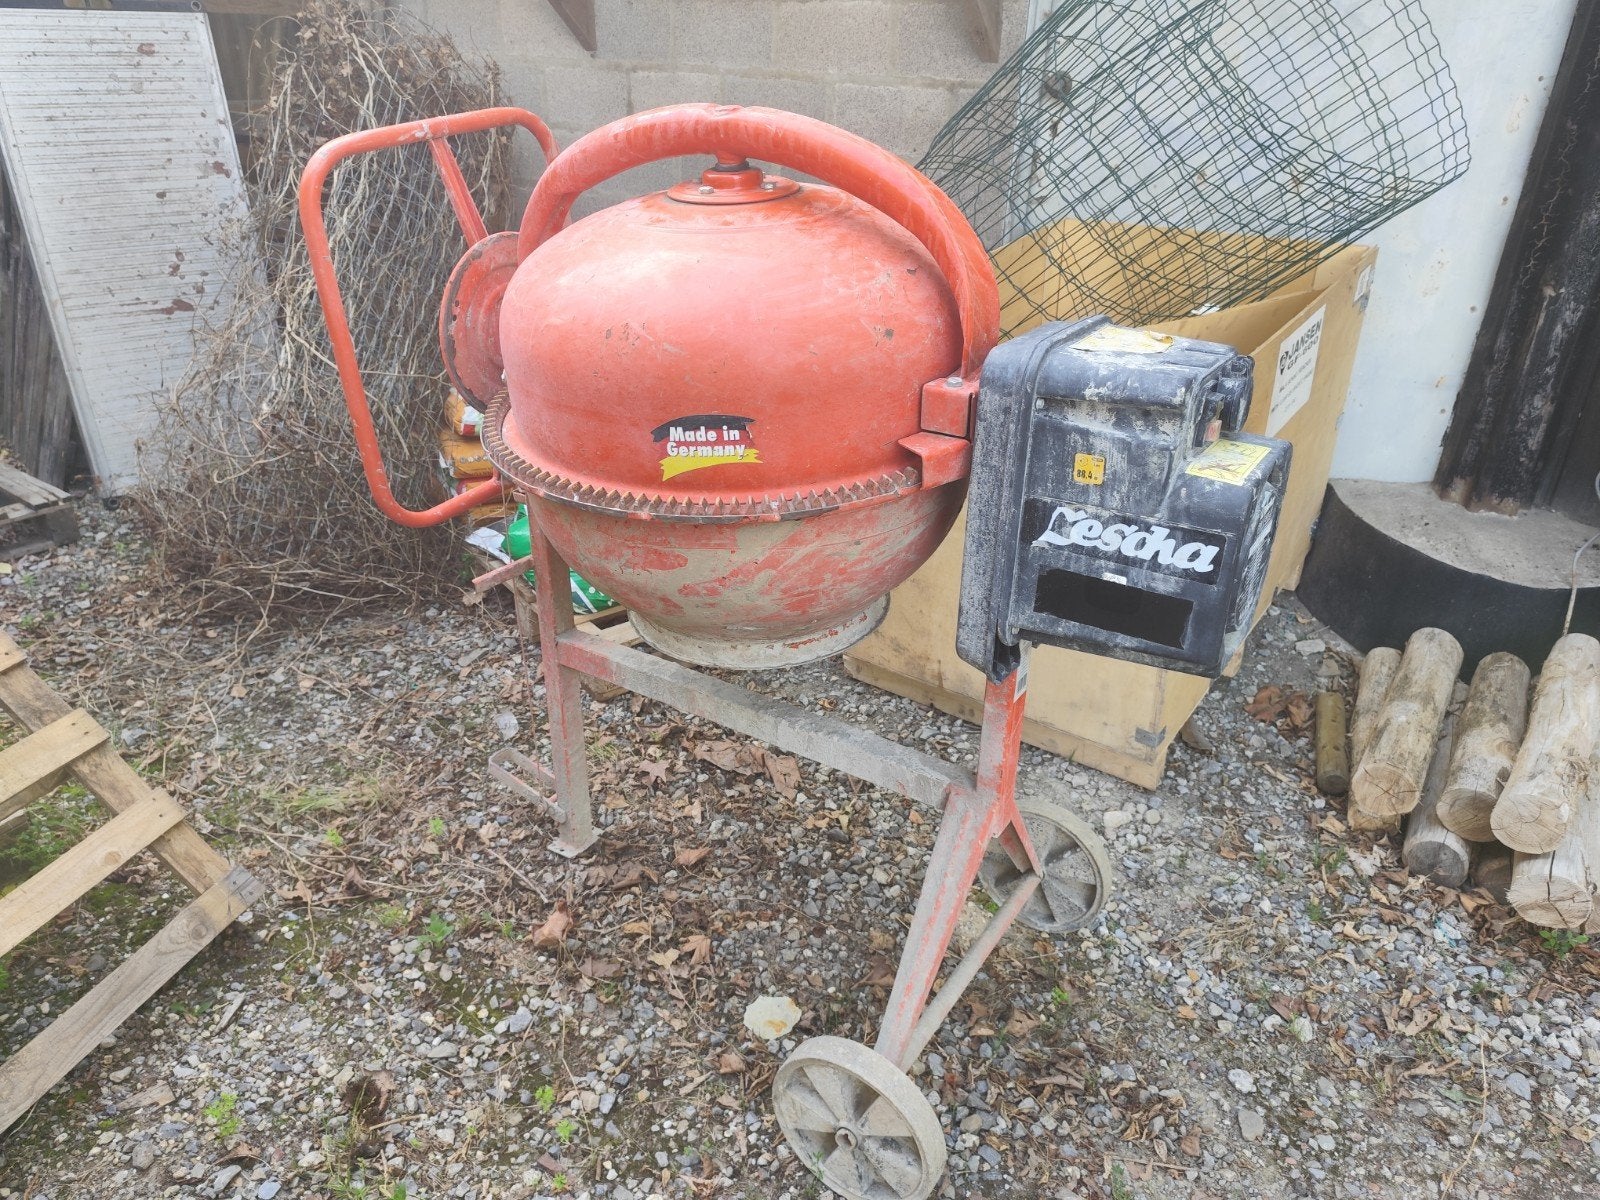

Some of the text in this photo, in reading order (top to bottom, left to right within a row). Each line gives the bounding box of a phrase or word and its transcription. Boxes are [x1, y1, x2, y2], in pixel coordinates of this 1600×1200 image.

[1289, 319, 1322, 360] JANSEN
[669, 425, 740, 442] Made in
[666, 441, 746, 460] Germany
[1031, 506, 1220, 573] Lescha
